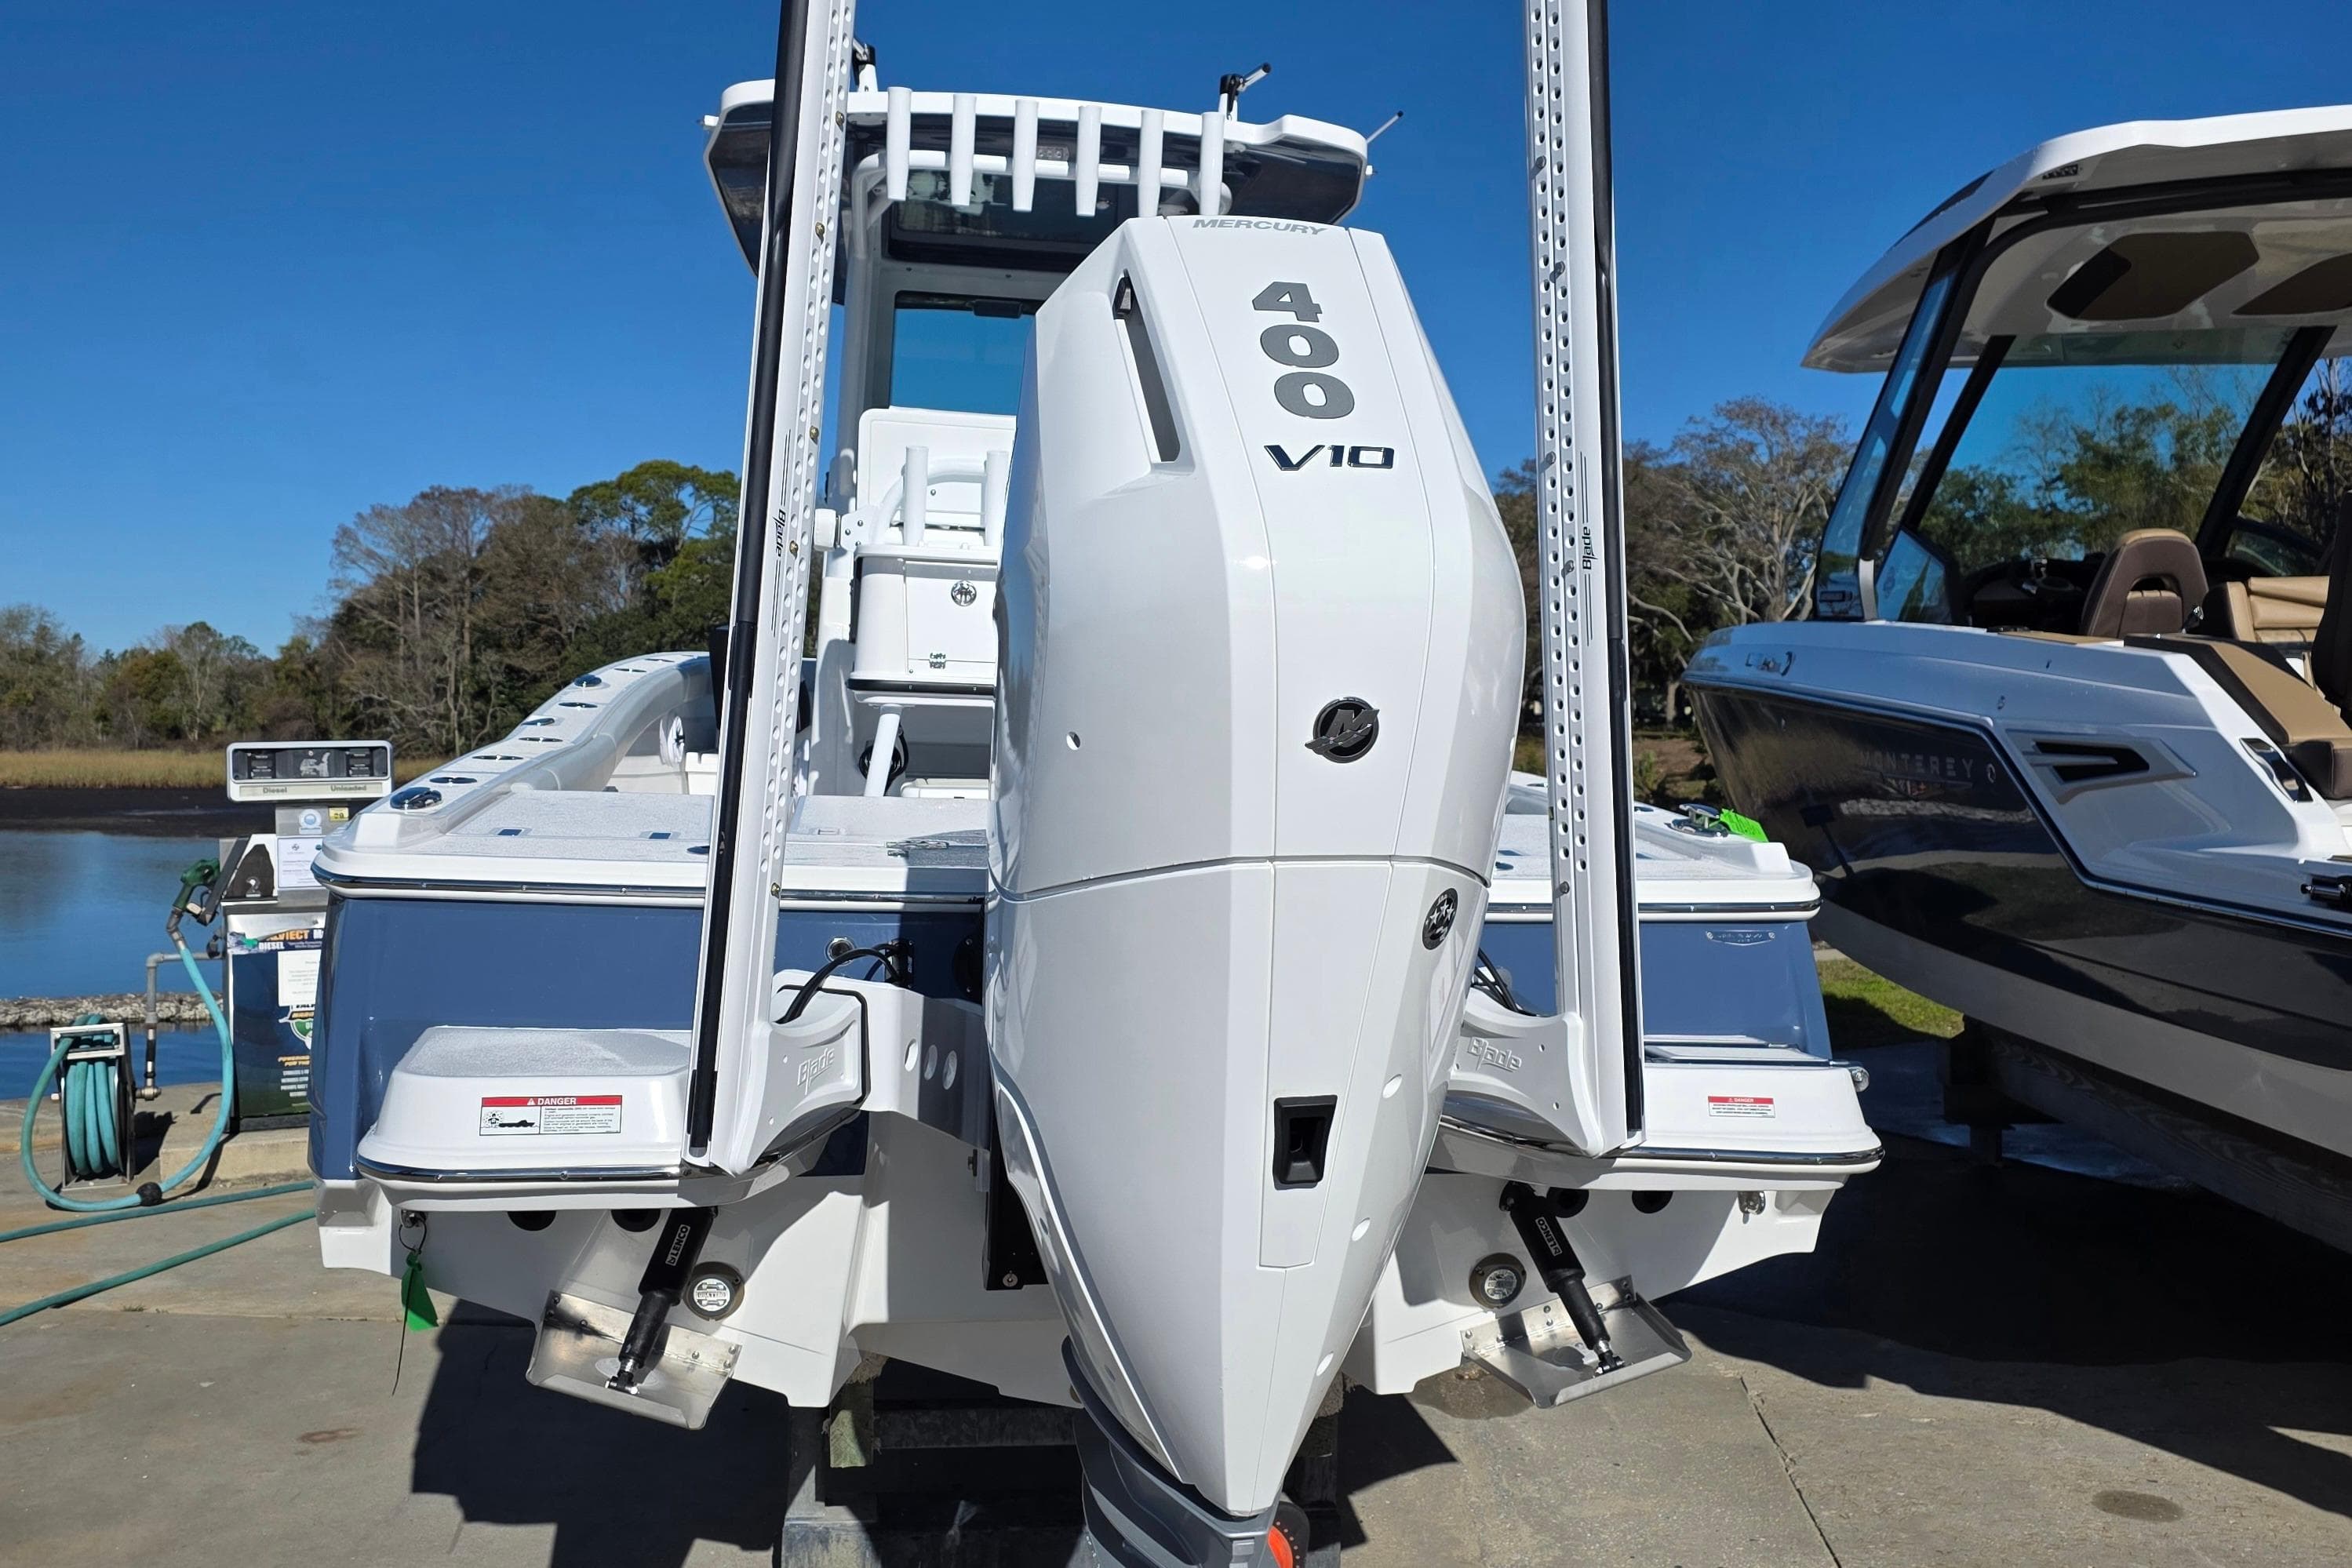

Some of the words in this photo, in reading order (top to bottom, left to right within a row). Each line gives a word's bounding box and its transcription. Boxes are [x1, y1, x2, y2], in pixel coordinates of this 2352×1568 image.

[1192, 219, 1328, 235] MERCURY
[1251, 281, 1356, 420] 400
[1264, 444, 1395, 471] V10
[773, 508, 786, 558] Blade
[1582, 526, 1598, 570] Blade
[1860, 750, 1973, 779] MONTEREY
[797, 1048, 835, 1096] Blade
[1467, 1037, 1523, 1073] Blade
[671, 1225, 689, 1258] LENCO
[1537, 1219, 1559, 1249] LENCO
